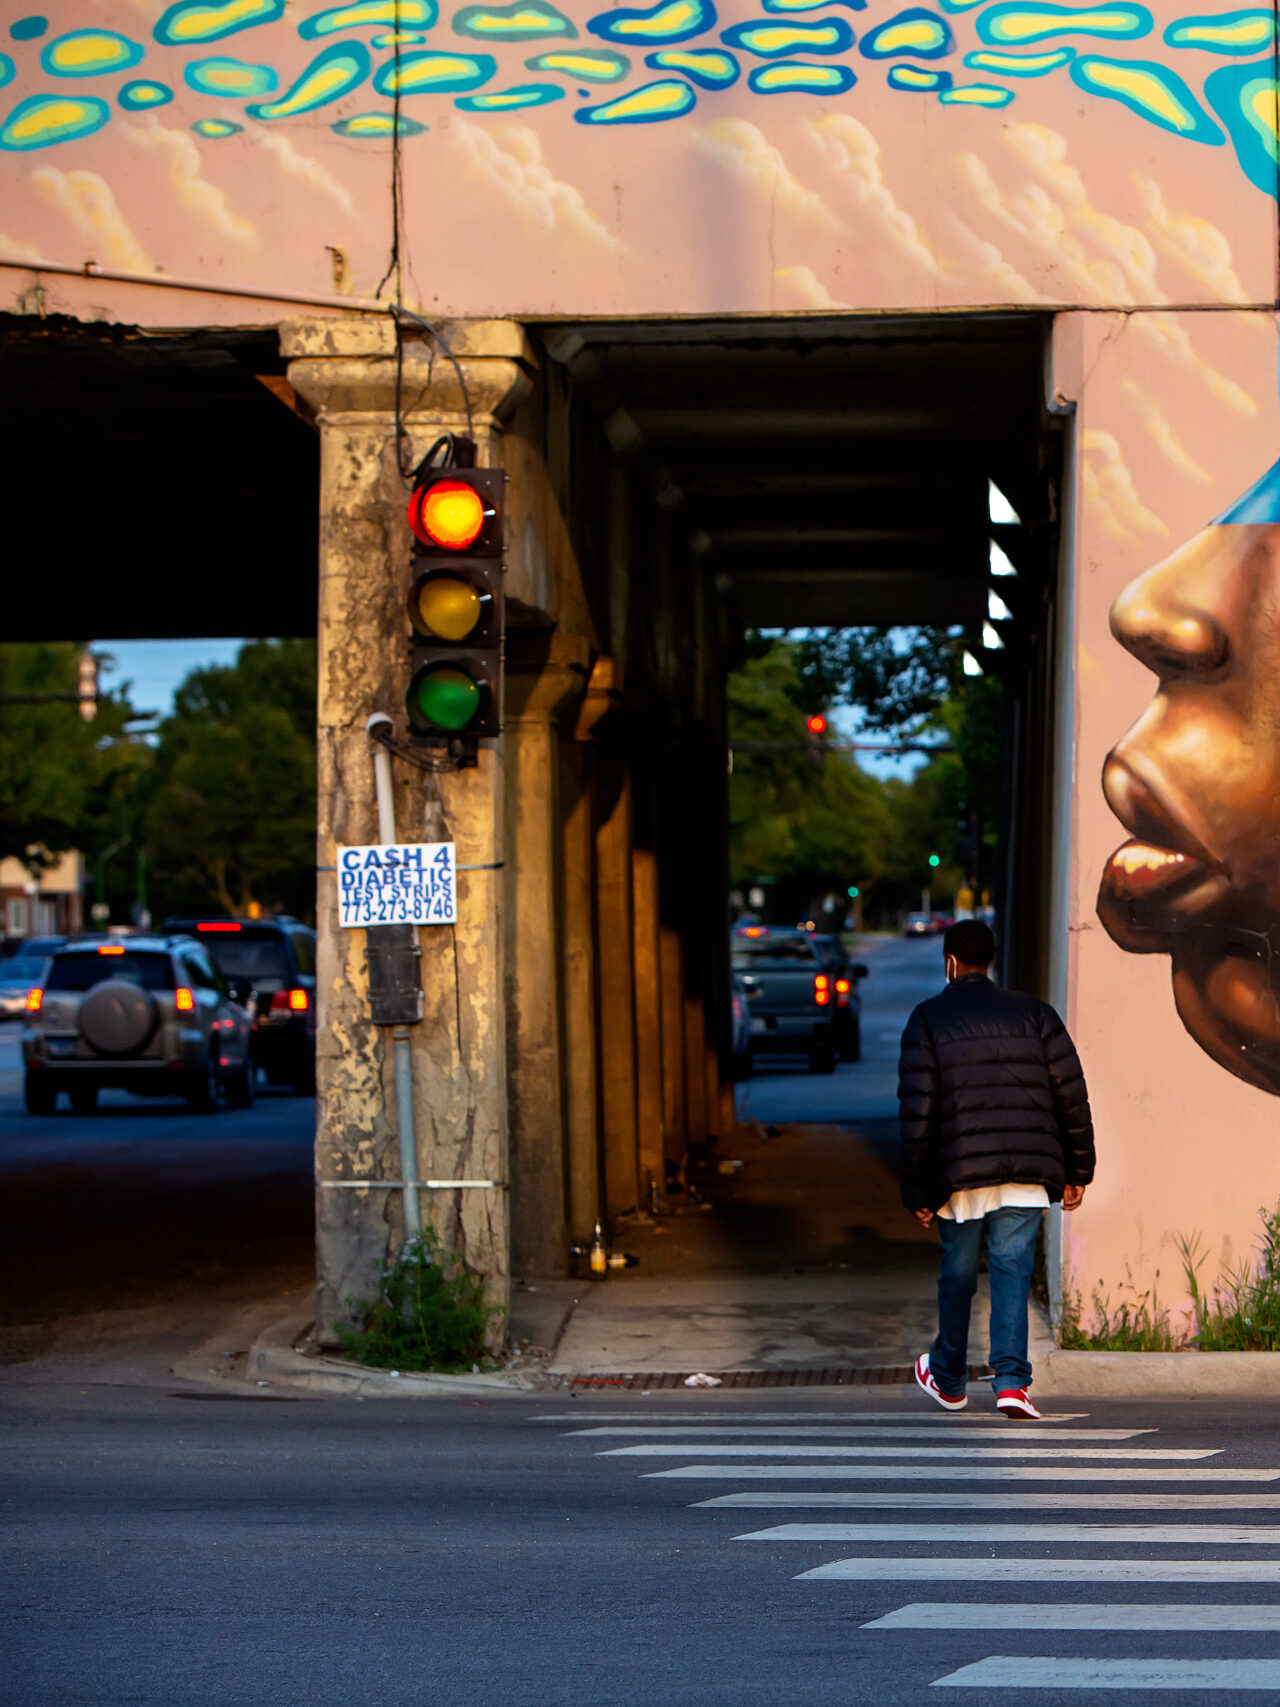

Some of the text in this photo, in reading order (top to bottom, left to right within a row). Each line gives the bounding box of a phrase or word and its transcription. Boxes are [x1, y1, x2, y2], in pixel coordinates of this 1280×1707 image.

[433, 846, 450, 867] 4
[342, 867, 452, 888] DIABETIC
[342, 882, 452, 901] TEST STRIPS
[342, 898, 453, 922] 773-273-8746
